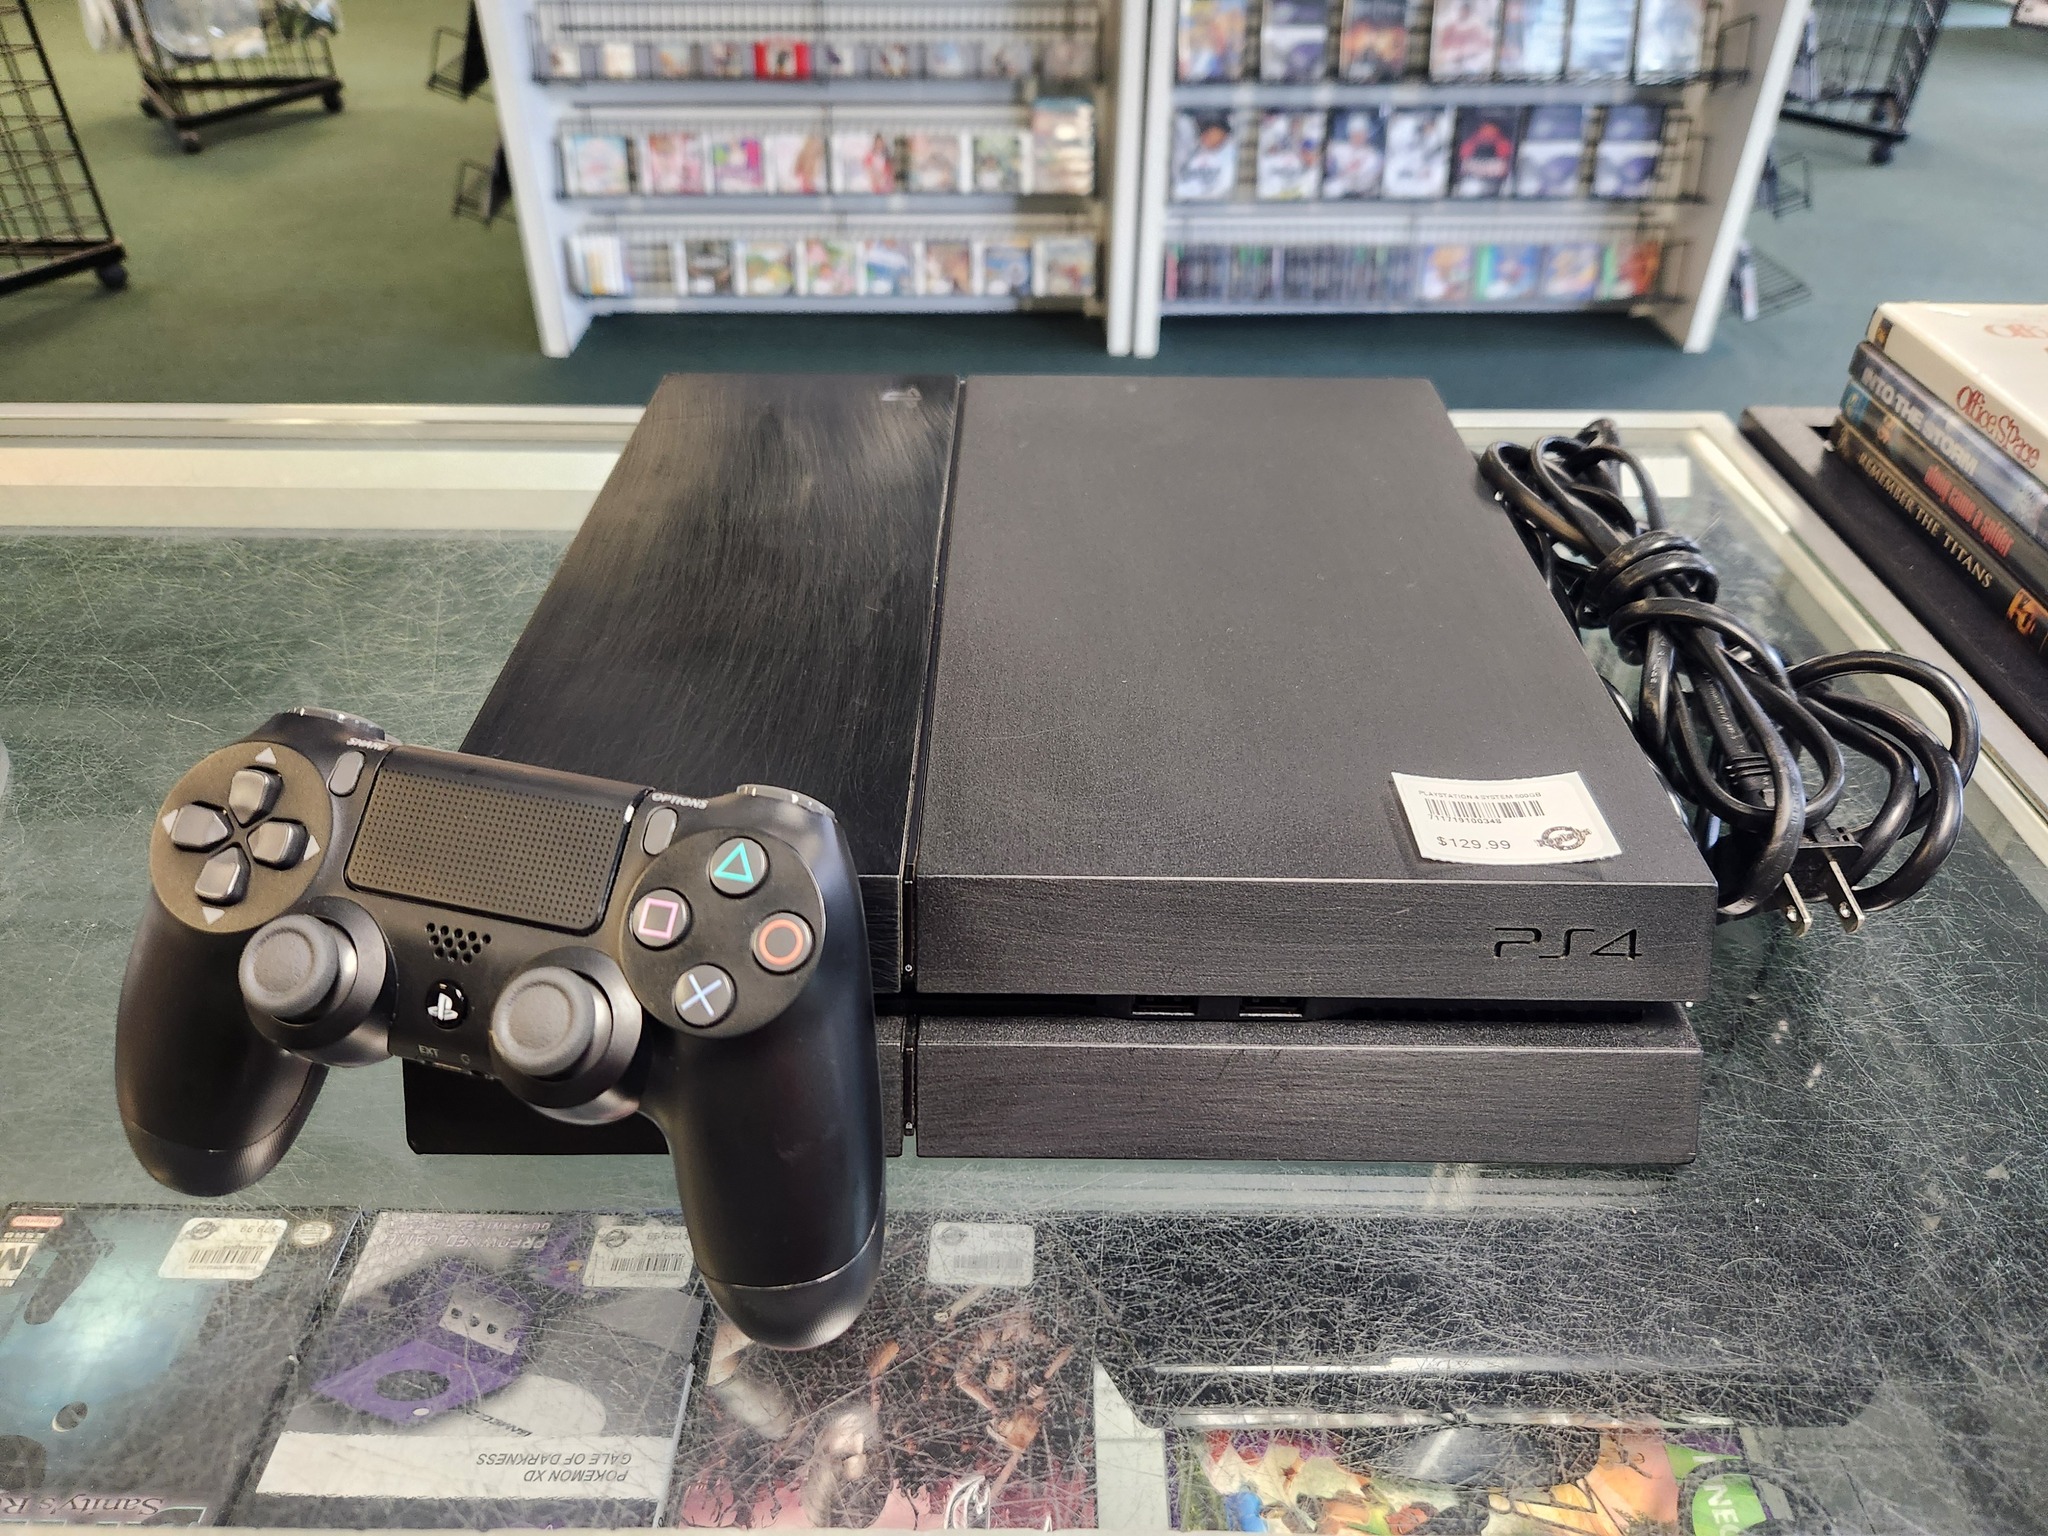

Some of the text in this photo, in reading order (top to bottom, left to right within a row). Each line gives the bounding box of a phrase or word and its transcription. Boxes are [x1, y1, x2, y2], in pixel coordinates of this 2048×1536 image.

[1861, 367, 1979, 477] INTO THE STORM
[1956, 386, 2041, 469] Office Space
[1857, 452, 1994, 589] REMEMBER THE TITANS
[651, 792, 710, 810] OPTIONS
[1418, 789, 1473, 800] PLAYSTATION
[1436, 835, 1511, 850] $129.99
[1493, 927, 1642, 960] PS4
[417, 1044, 439, 1058] EXT
[476, 1453, 632, 1466] GALE OF DARKNESS
[523, 1469, 629, 1483] POKEMON XD
[39, 1493, 164, 1516] Sanity's
